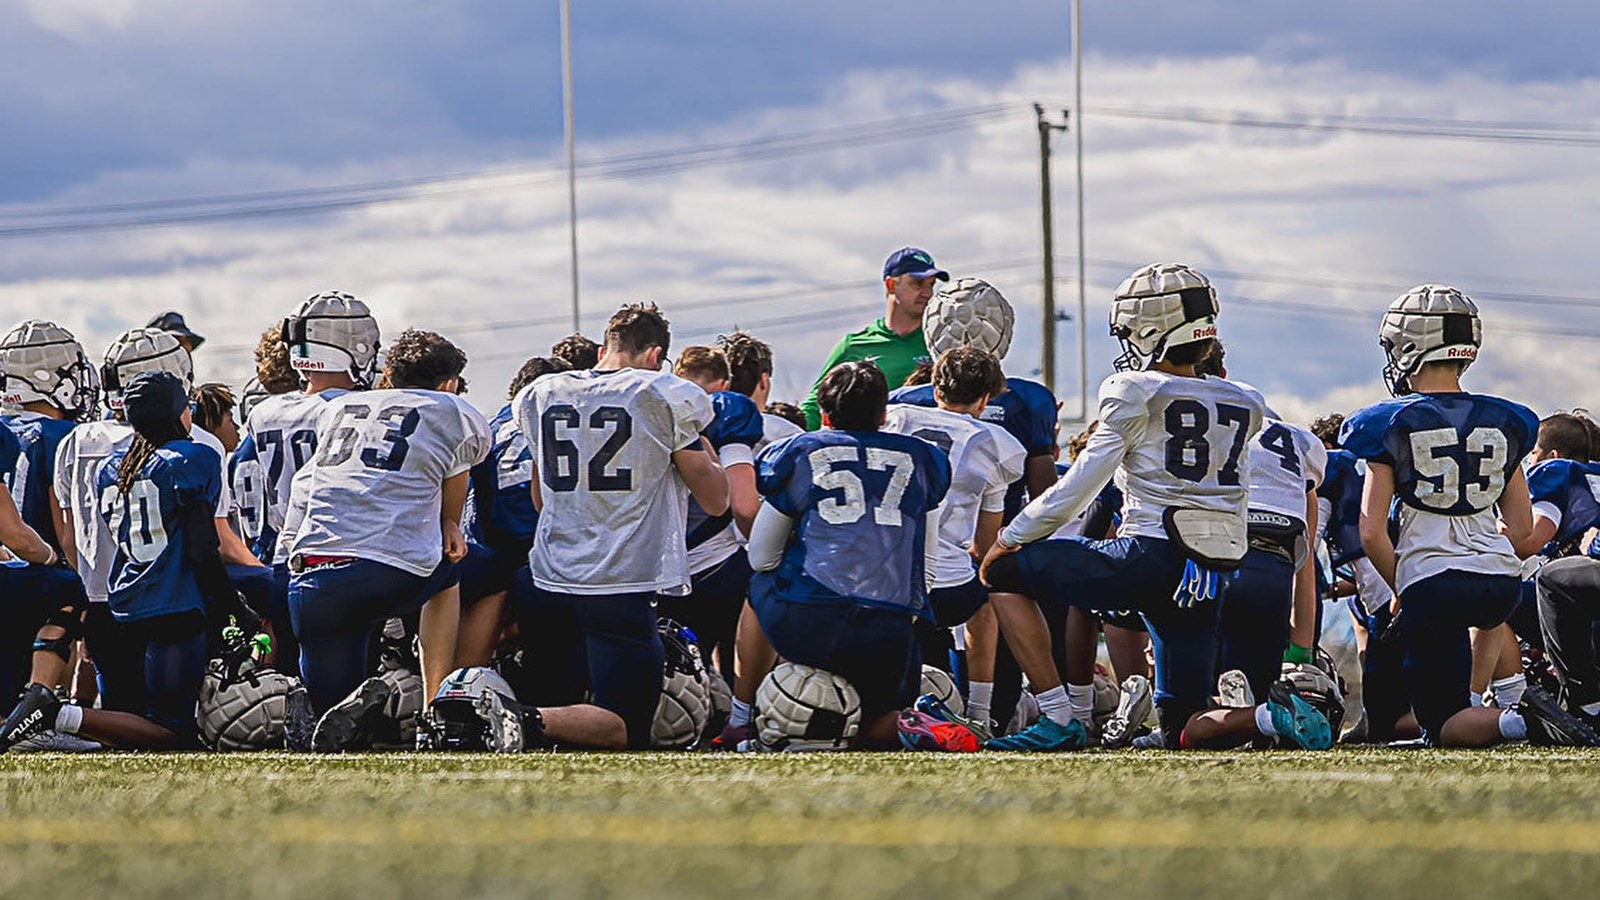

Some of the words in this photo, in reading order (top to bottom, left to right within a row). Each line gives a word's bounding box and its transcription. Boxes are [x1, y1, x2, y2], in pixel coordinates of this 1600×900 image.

[315, 404, 420, 471] 63
[542, 403, 633, 492] 62
[1164, 399, 1250, 486] 87
[1409, 427, 1508, 510] 53
[808, 445, 914, 526] 57
